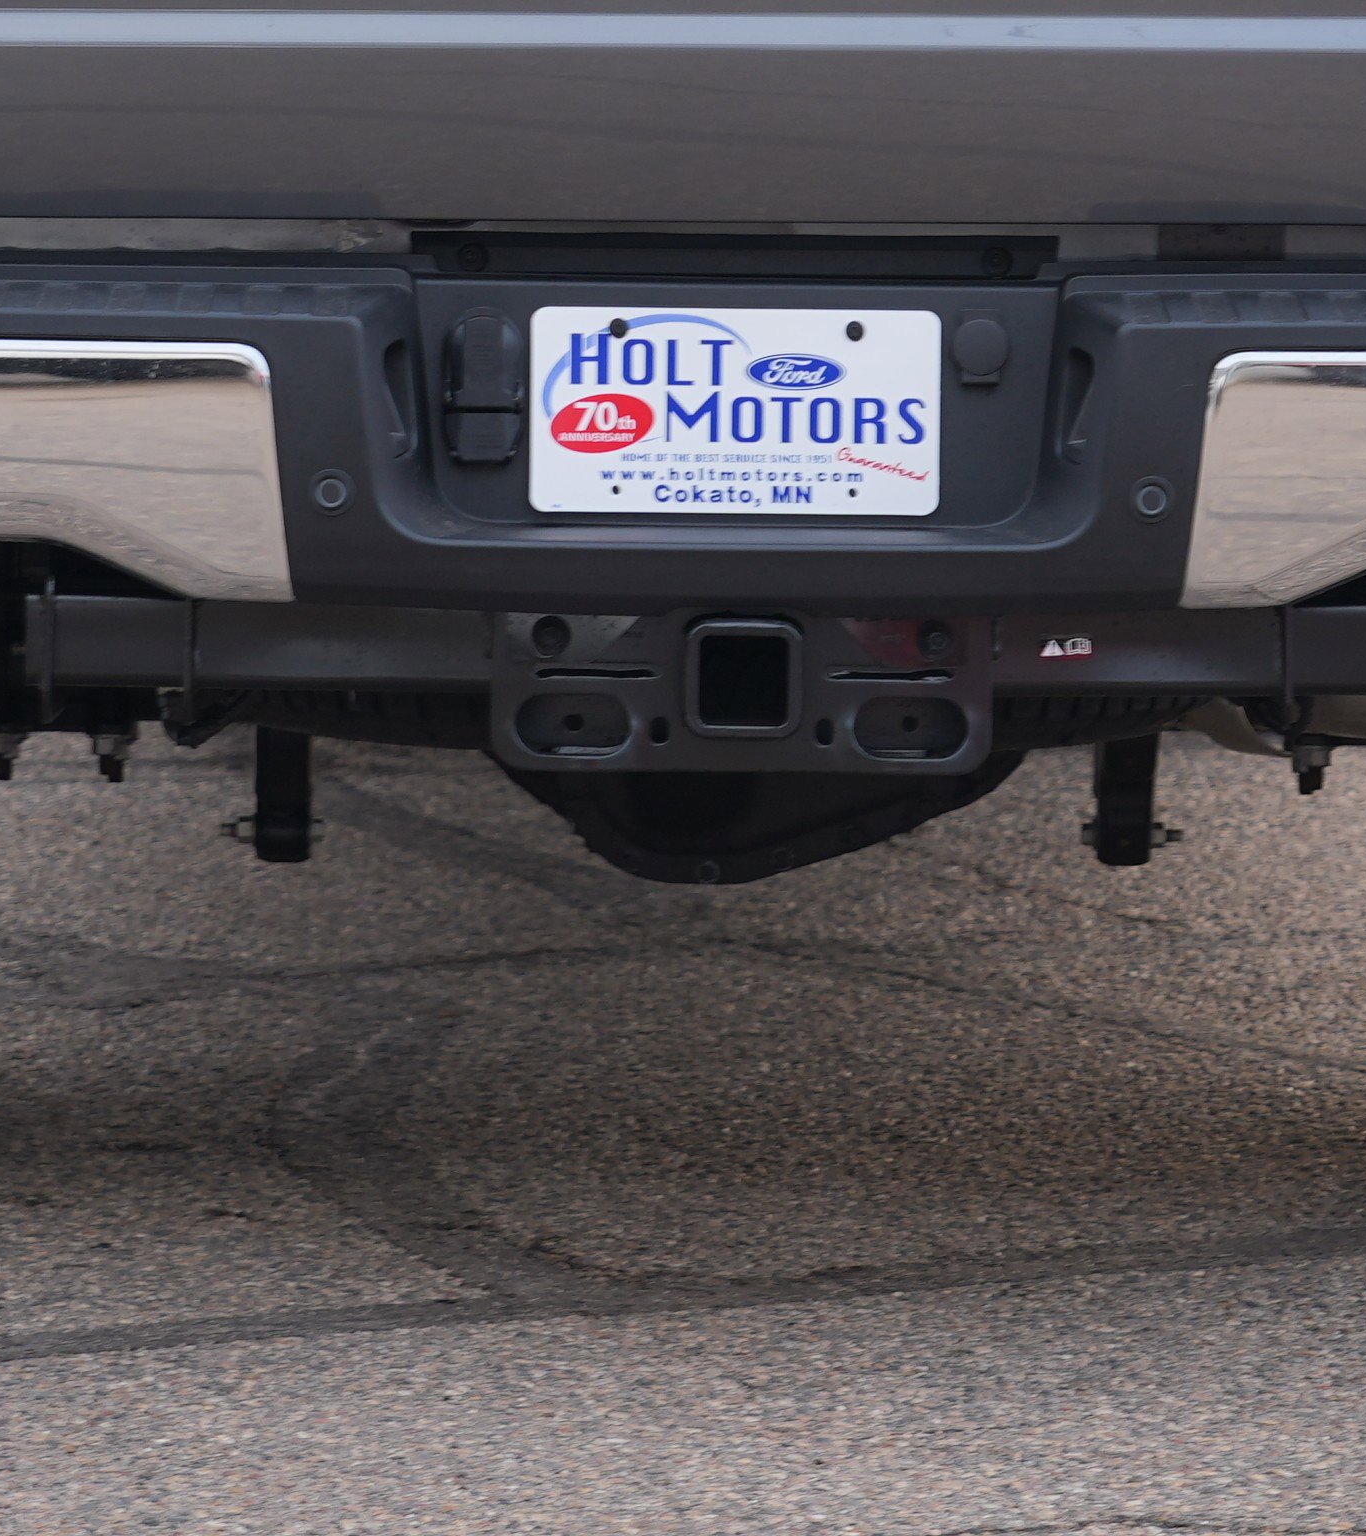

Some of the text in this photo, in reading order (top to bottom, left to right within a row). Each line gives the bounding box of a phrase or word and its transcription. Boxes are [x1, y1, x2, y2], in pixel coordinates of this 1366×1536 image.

[570, 332, 734, 386] HOLT
[761, 358, 826, 384] Ford
[573, 401, 636, 431] 70th
[666, 391, 926, 445] MOTORS
[557, 432, 635, 443] ANNIVERSARY
[622, 453, 651, 463] HOME
[656, 453, 667, 463] OF
[673, 453, 691, 463] THE
[695, 453, 719, 463] BEST
[724, 453, 766, 463] SERVICE
[771, 453, 802, 463] SINCE
[600, 468, 864, 483] www.holtmotors.com
[654, 485, 813, 507] Cokato, MN
